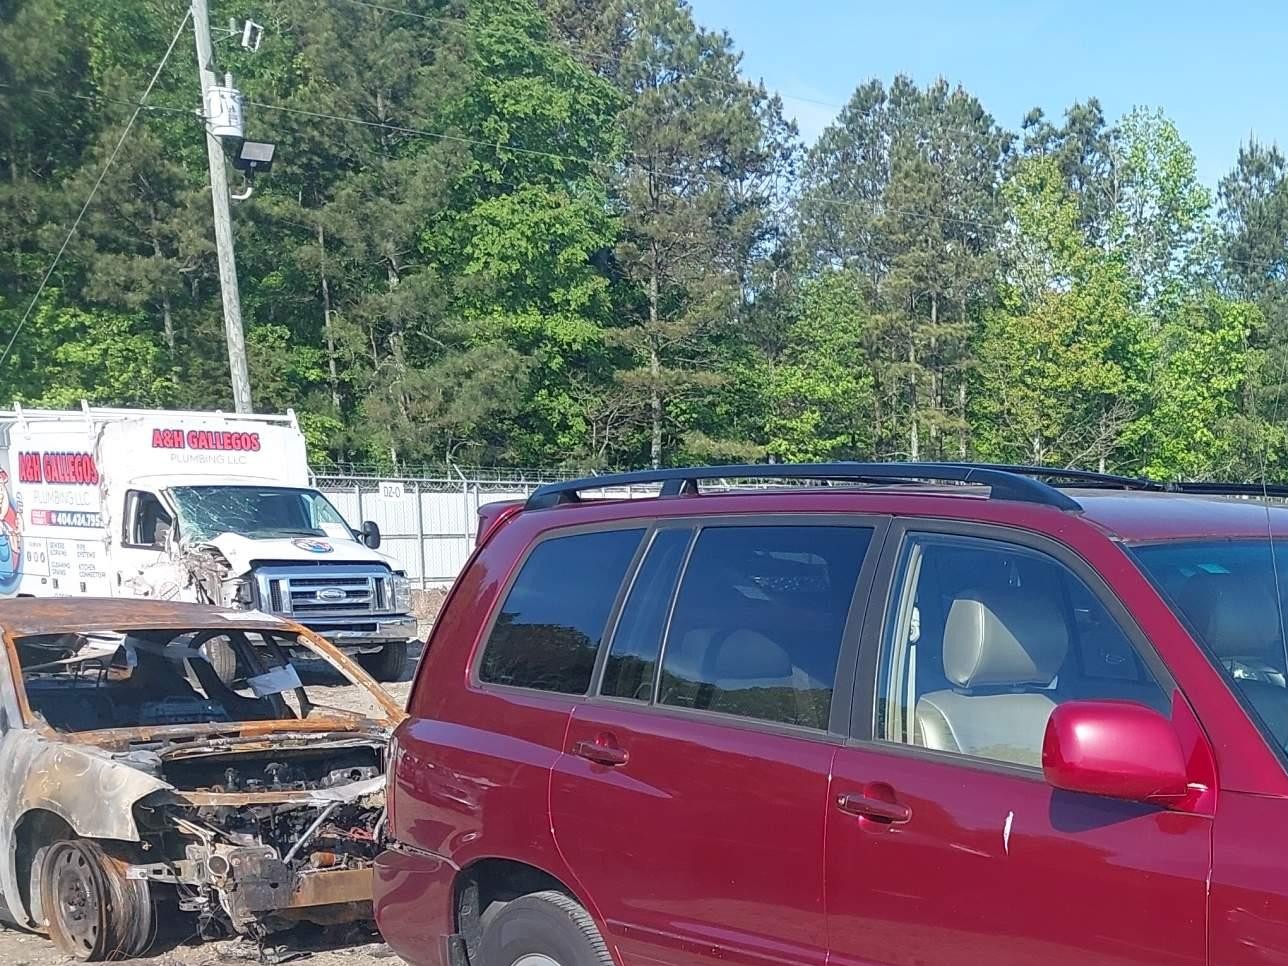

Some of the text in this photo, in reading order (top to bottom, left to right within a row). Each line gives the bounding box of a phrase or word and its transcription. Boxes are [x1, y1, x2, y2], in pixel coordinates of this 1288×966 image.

[152, 428, 261, 452] A&H GALLEGOS
[18, 451, 99, 486] A&H GALLEGOS
[170, 453, 247, 465] PLUMBING LLC
